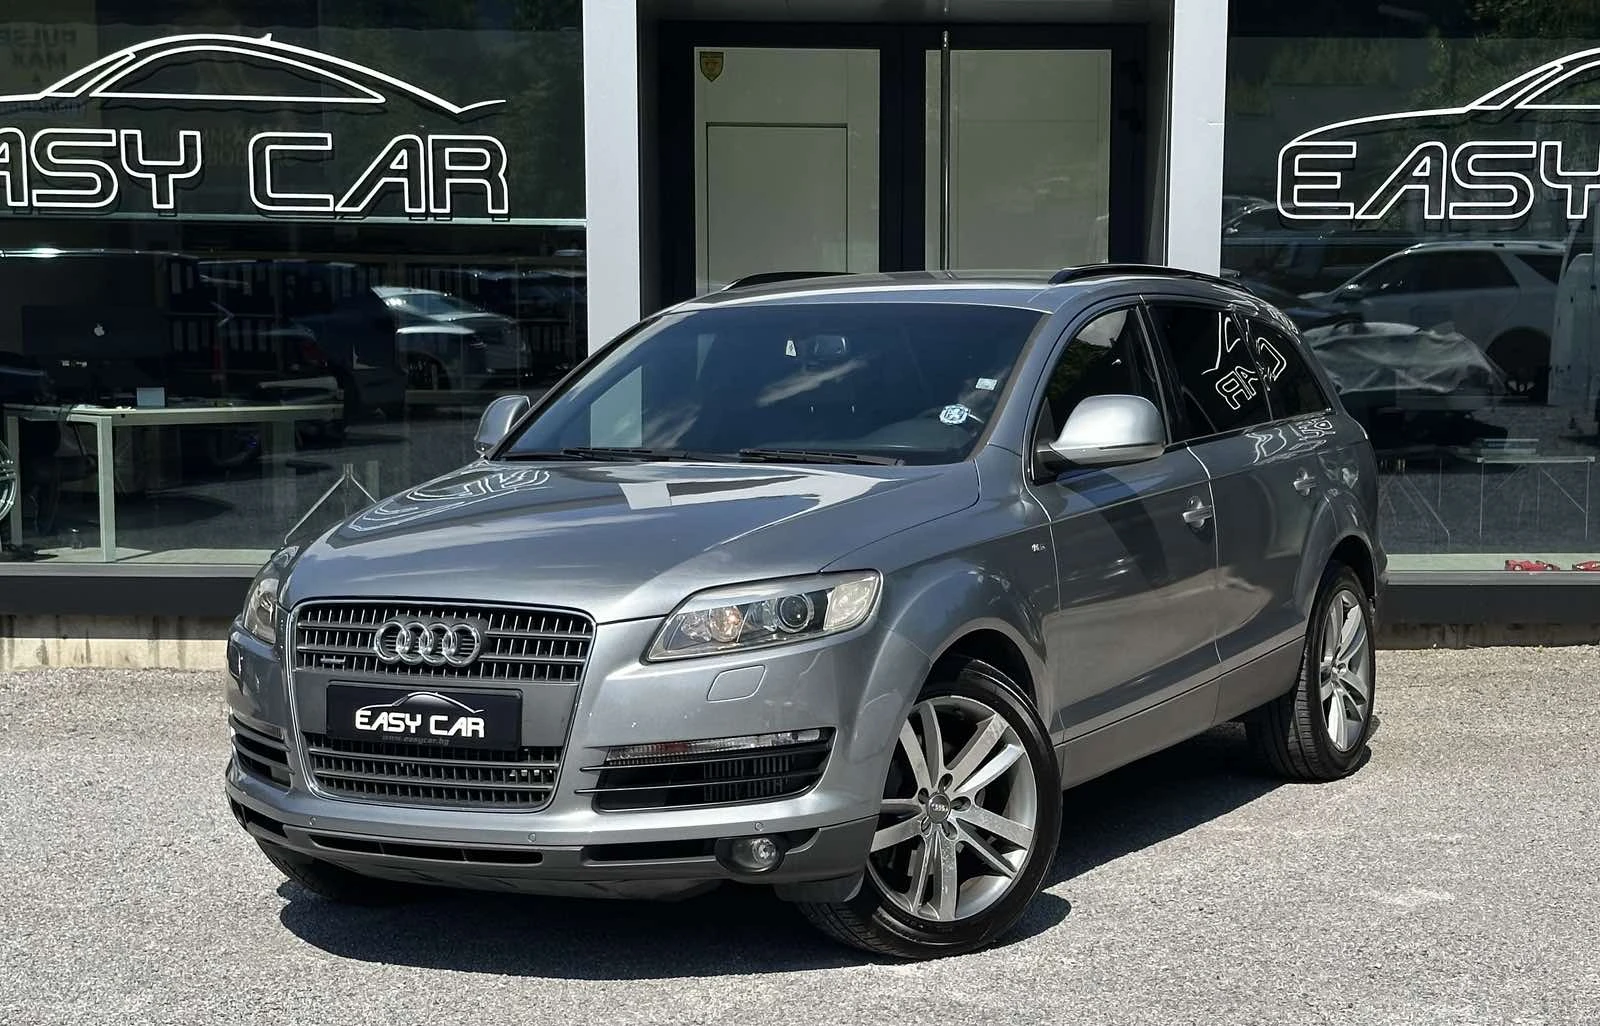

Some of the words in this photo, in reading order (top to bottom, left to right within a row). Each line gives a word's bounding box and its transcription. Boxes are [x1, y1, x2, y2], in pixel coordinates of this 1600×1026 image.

[249, 132, 508, 214] CAR
[1276, 141, 1600, 219] EASY
[355, 709, 422, 733] EASY
[429, 715, 485, 738] CAR
